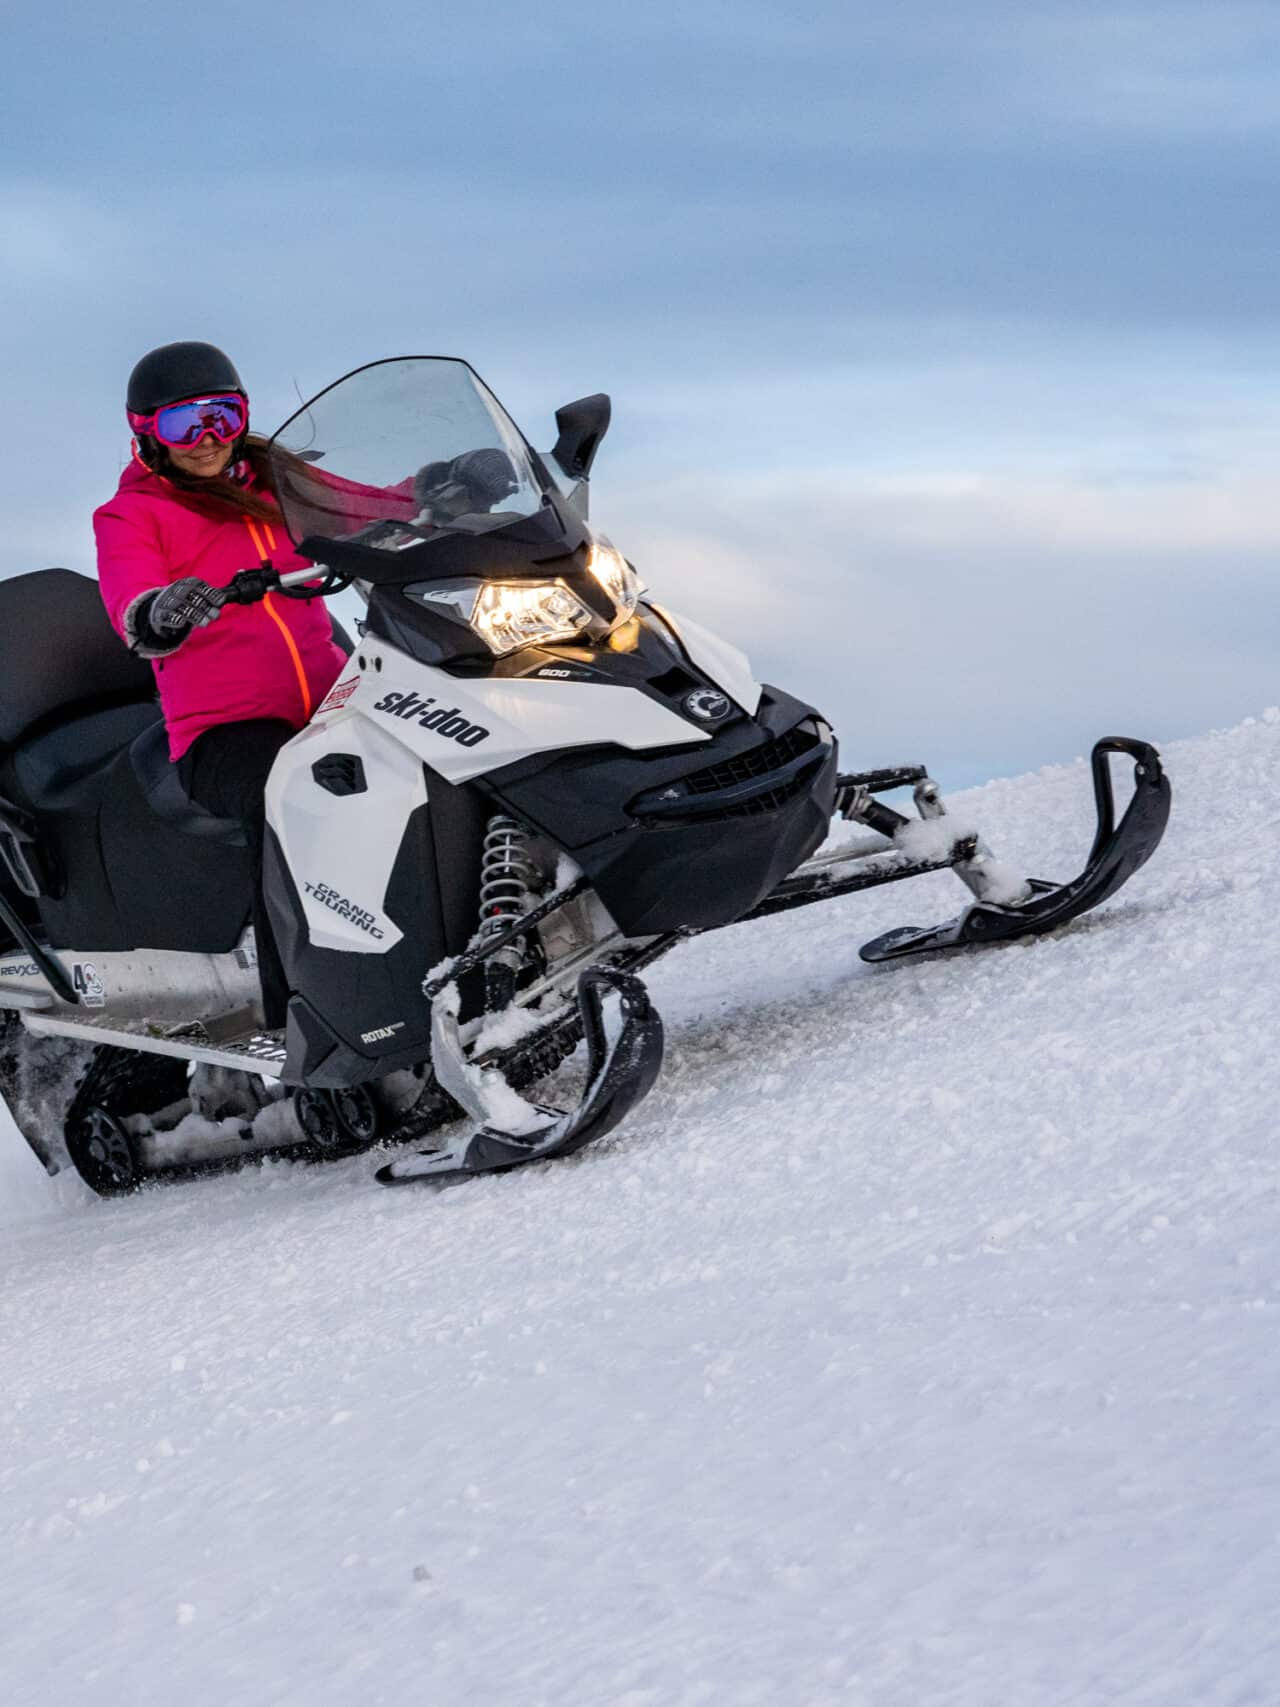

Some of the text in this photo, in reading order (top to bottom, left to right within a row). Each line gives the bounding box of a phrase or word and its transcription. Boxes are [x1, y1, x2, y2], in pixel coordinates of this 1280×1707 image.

[537, 668, 571, 678] 600
[374, 691, 490, 748] ski-doo
[303, 881, 385, 940] TOURING
[317, 882, 376, 924] GRAND
[360, 1025, 396, 1045] ROTAX
